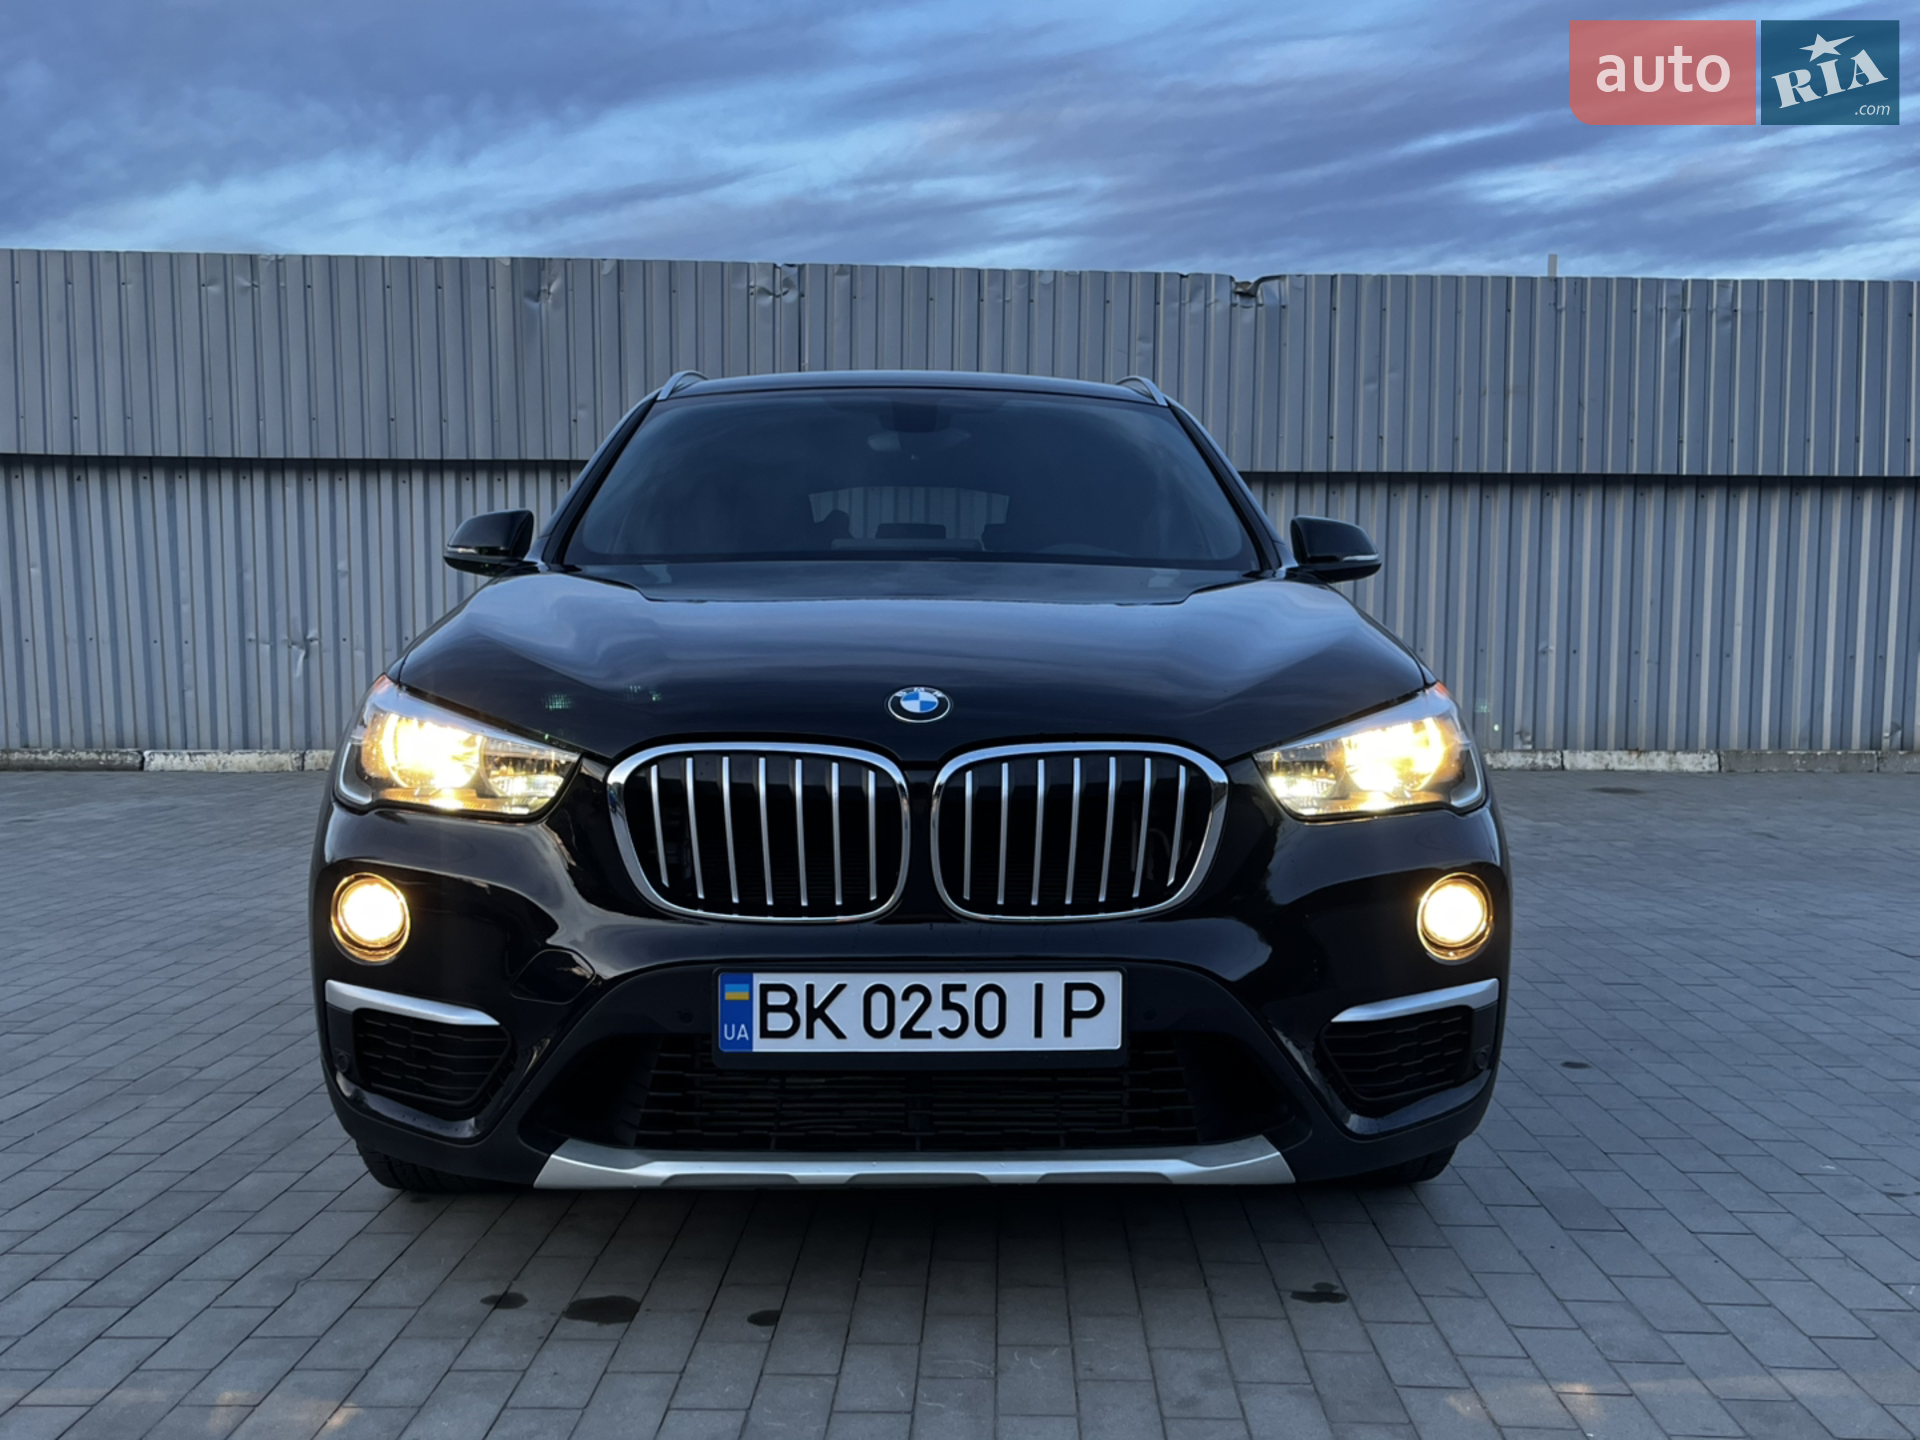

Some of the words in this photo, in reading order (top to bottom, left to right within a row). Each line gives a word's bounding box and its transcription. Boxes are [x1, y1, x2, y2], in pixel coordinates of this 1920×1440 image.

[758, 982, 847, 1040] BK
[862, 982, 1007, 1040] 0250
[1033, 982, 1105, 1039] IP
[723, 1023, 749, 1041] UA
